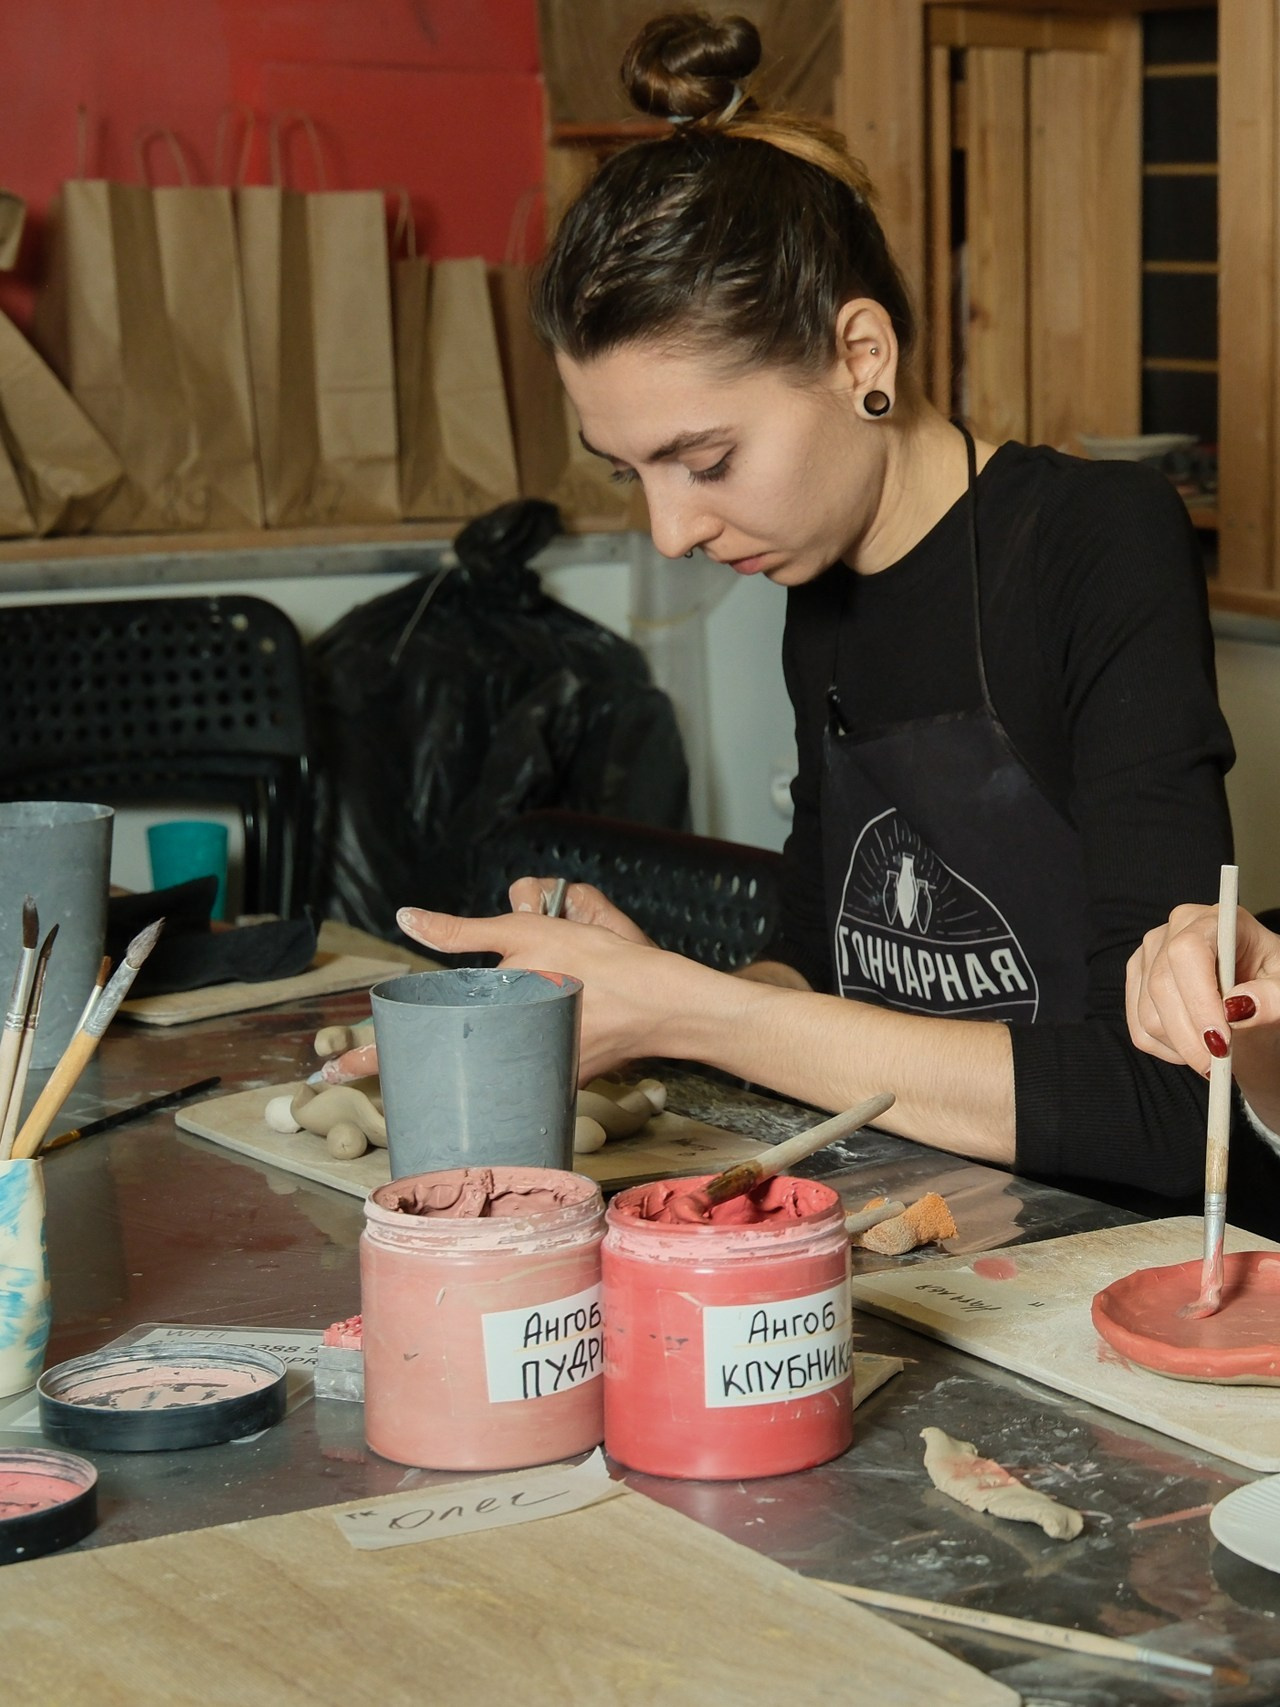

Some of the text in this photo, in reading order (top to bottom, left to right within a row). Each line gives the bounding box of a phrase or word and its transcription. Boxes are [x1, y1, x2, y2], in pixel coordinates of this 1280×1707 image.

[839, 924, 1029, 1002] ГОНЧАРНАЯ
[523, 1301, 602, 1349] Ангоб
[748, 1301, 836, 1344] Ангоб
[522, 1331, 604, 1399] ПУДР
